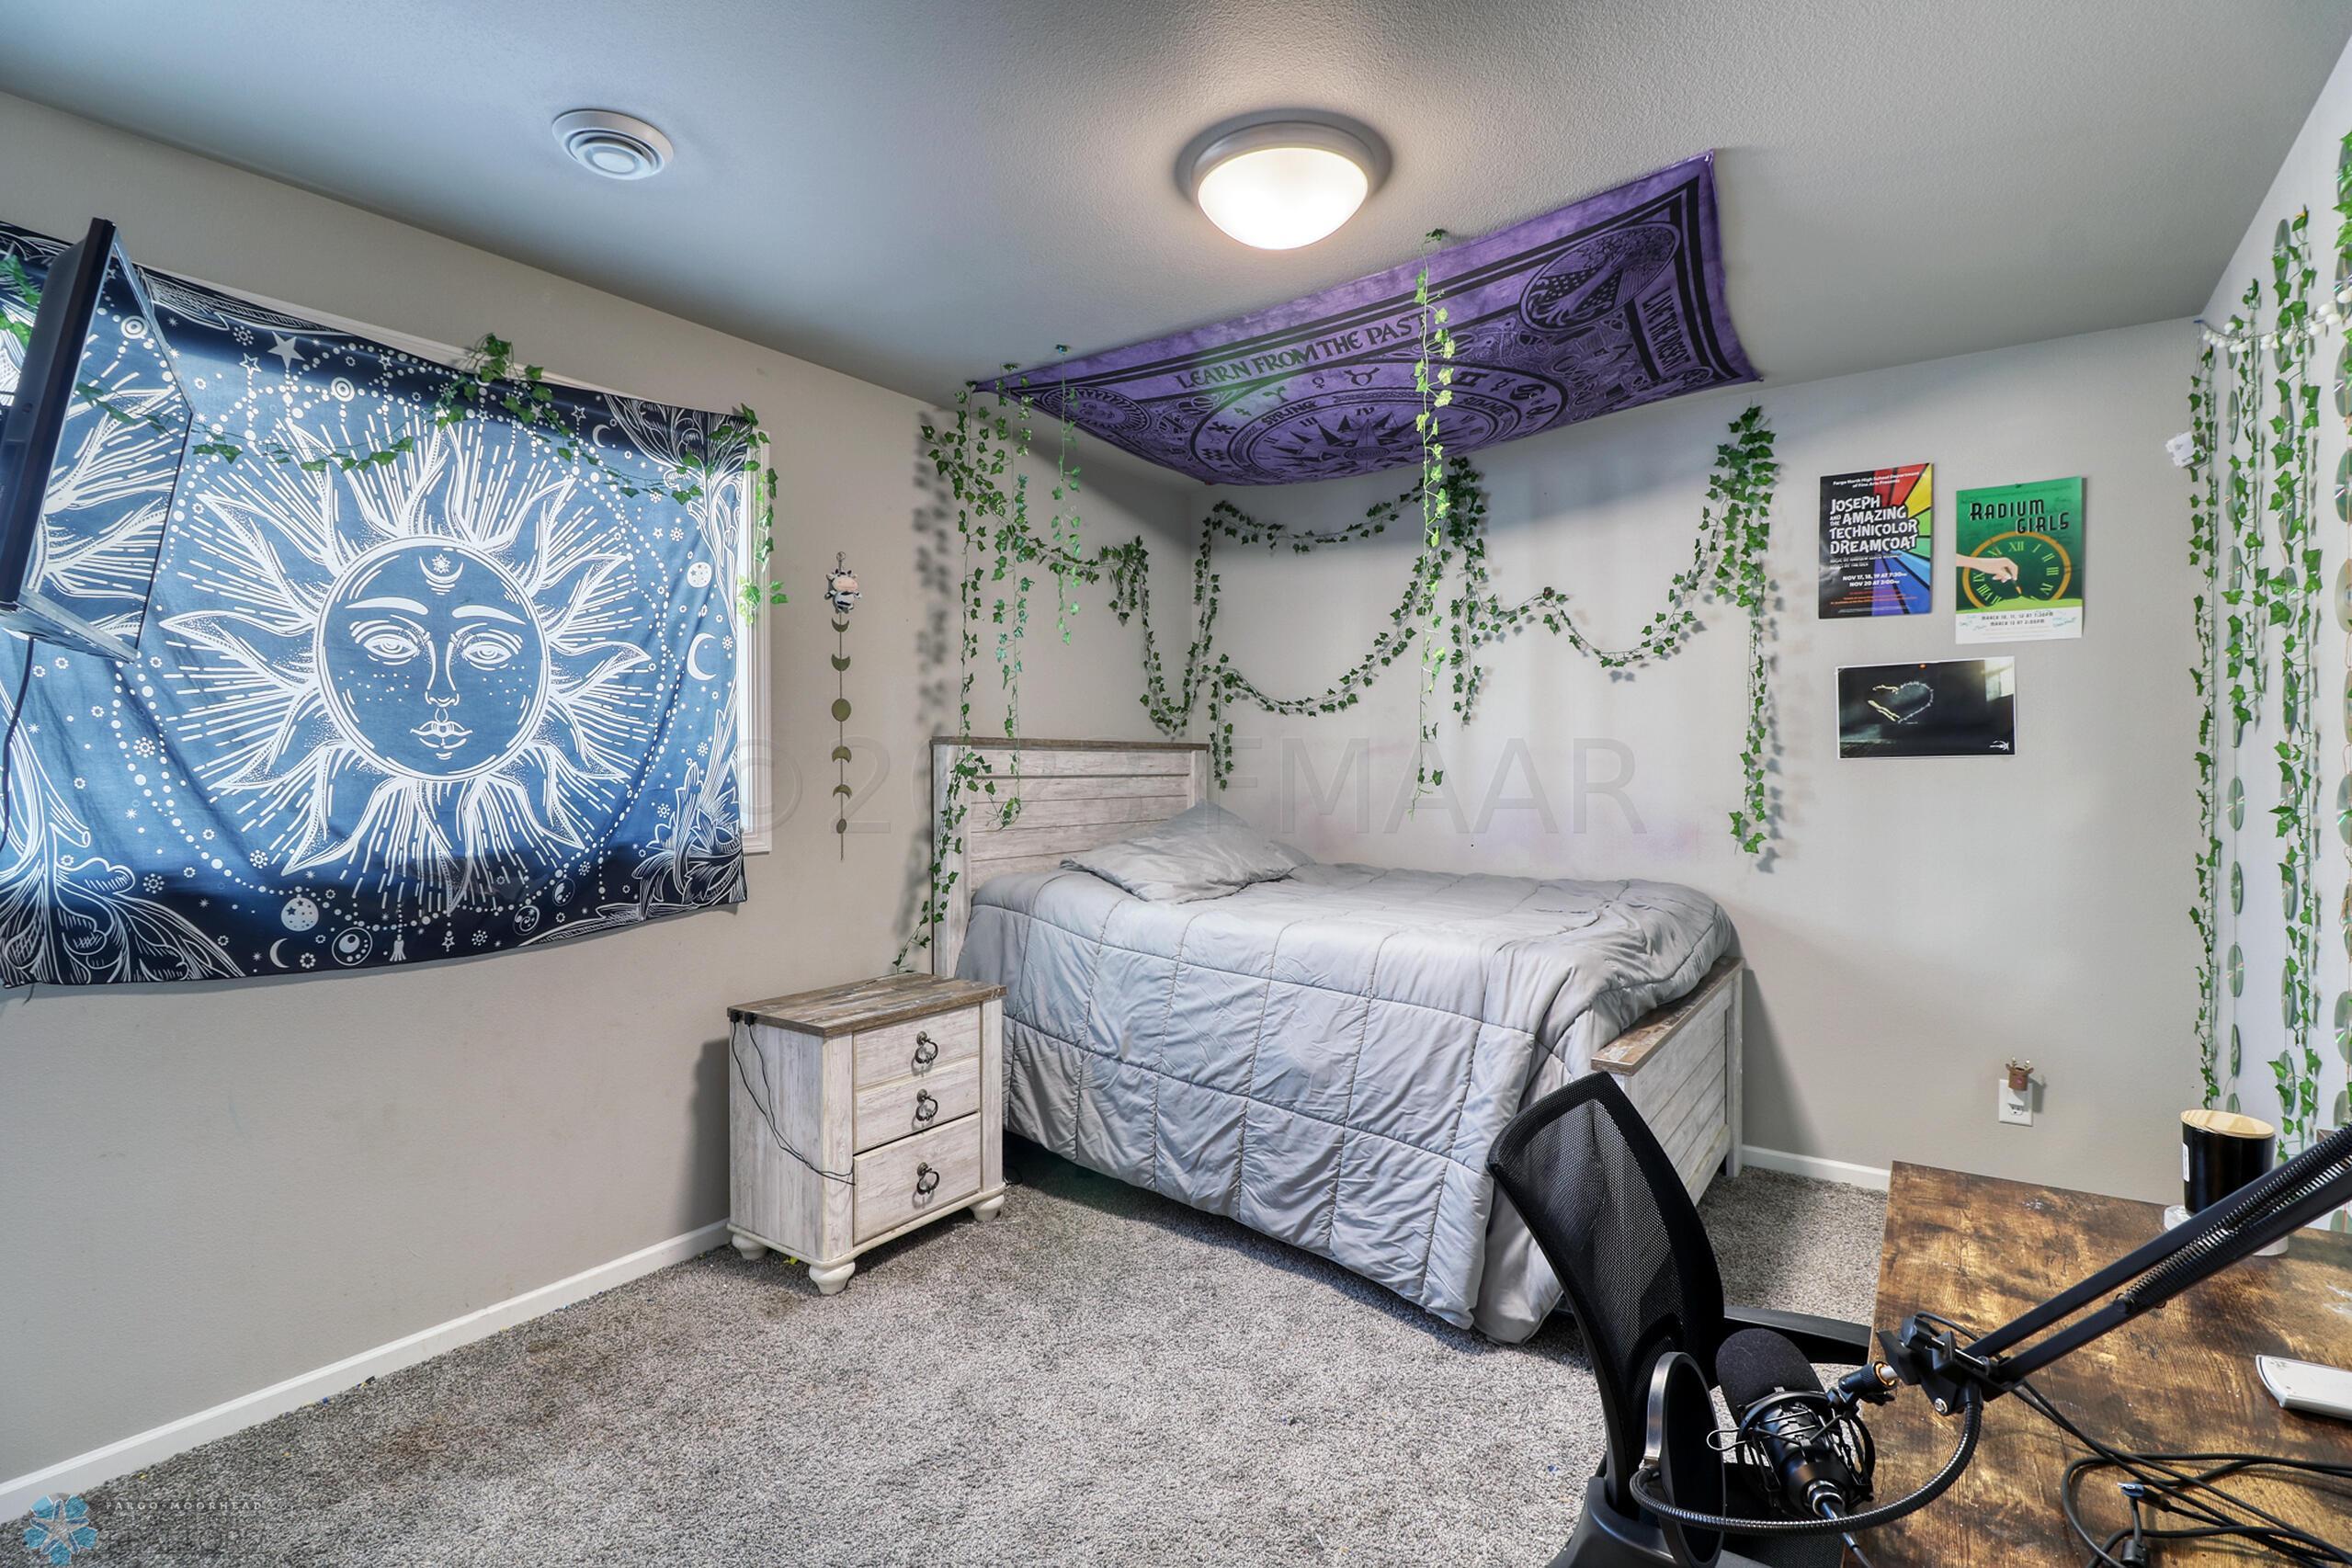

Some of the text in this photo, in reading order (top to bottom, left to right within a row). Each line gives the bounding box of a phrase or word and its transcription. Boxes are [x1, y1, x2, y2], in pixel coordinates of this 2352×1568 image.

[1176, 310, 1431, 389] LEARN FROM THE PAST
[1261, 401, 1318, 426] SPRING
[1830, 494, 1880, 515] JOSEPH
[1969, 499, 2045, 521] RADIUM
[1842, 505, 1906, 526] AMAZING
[2016, 512, 2070, 534] GIRLS
[1829, 519, 1918, 540] TECHNICOLOR
[1830, 534, 1918, 555] DREAMCOAT
[2008, 541, 2024, 551] XII
